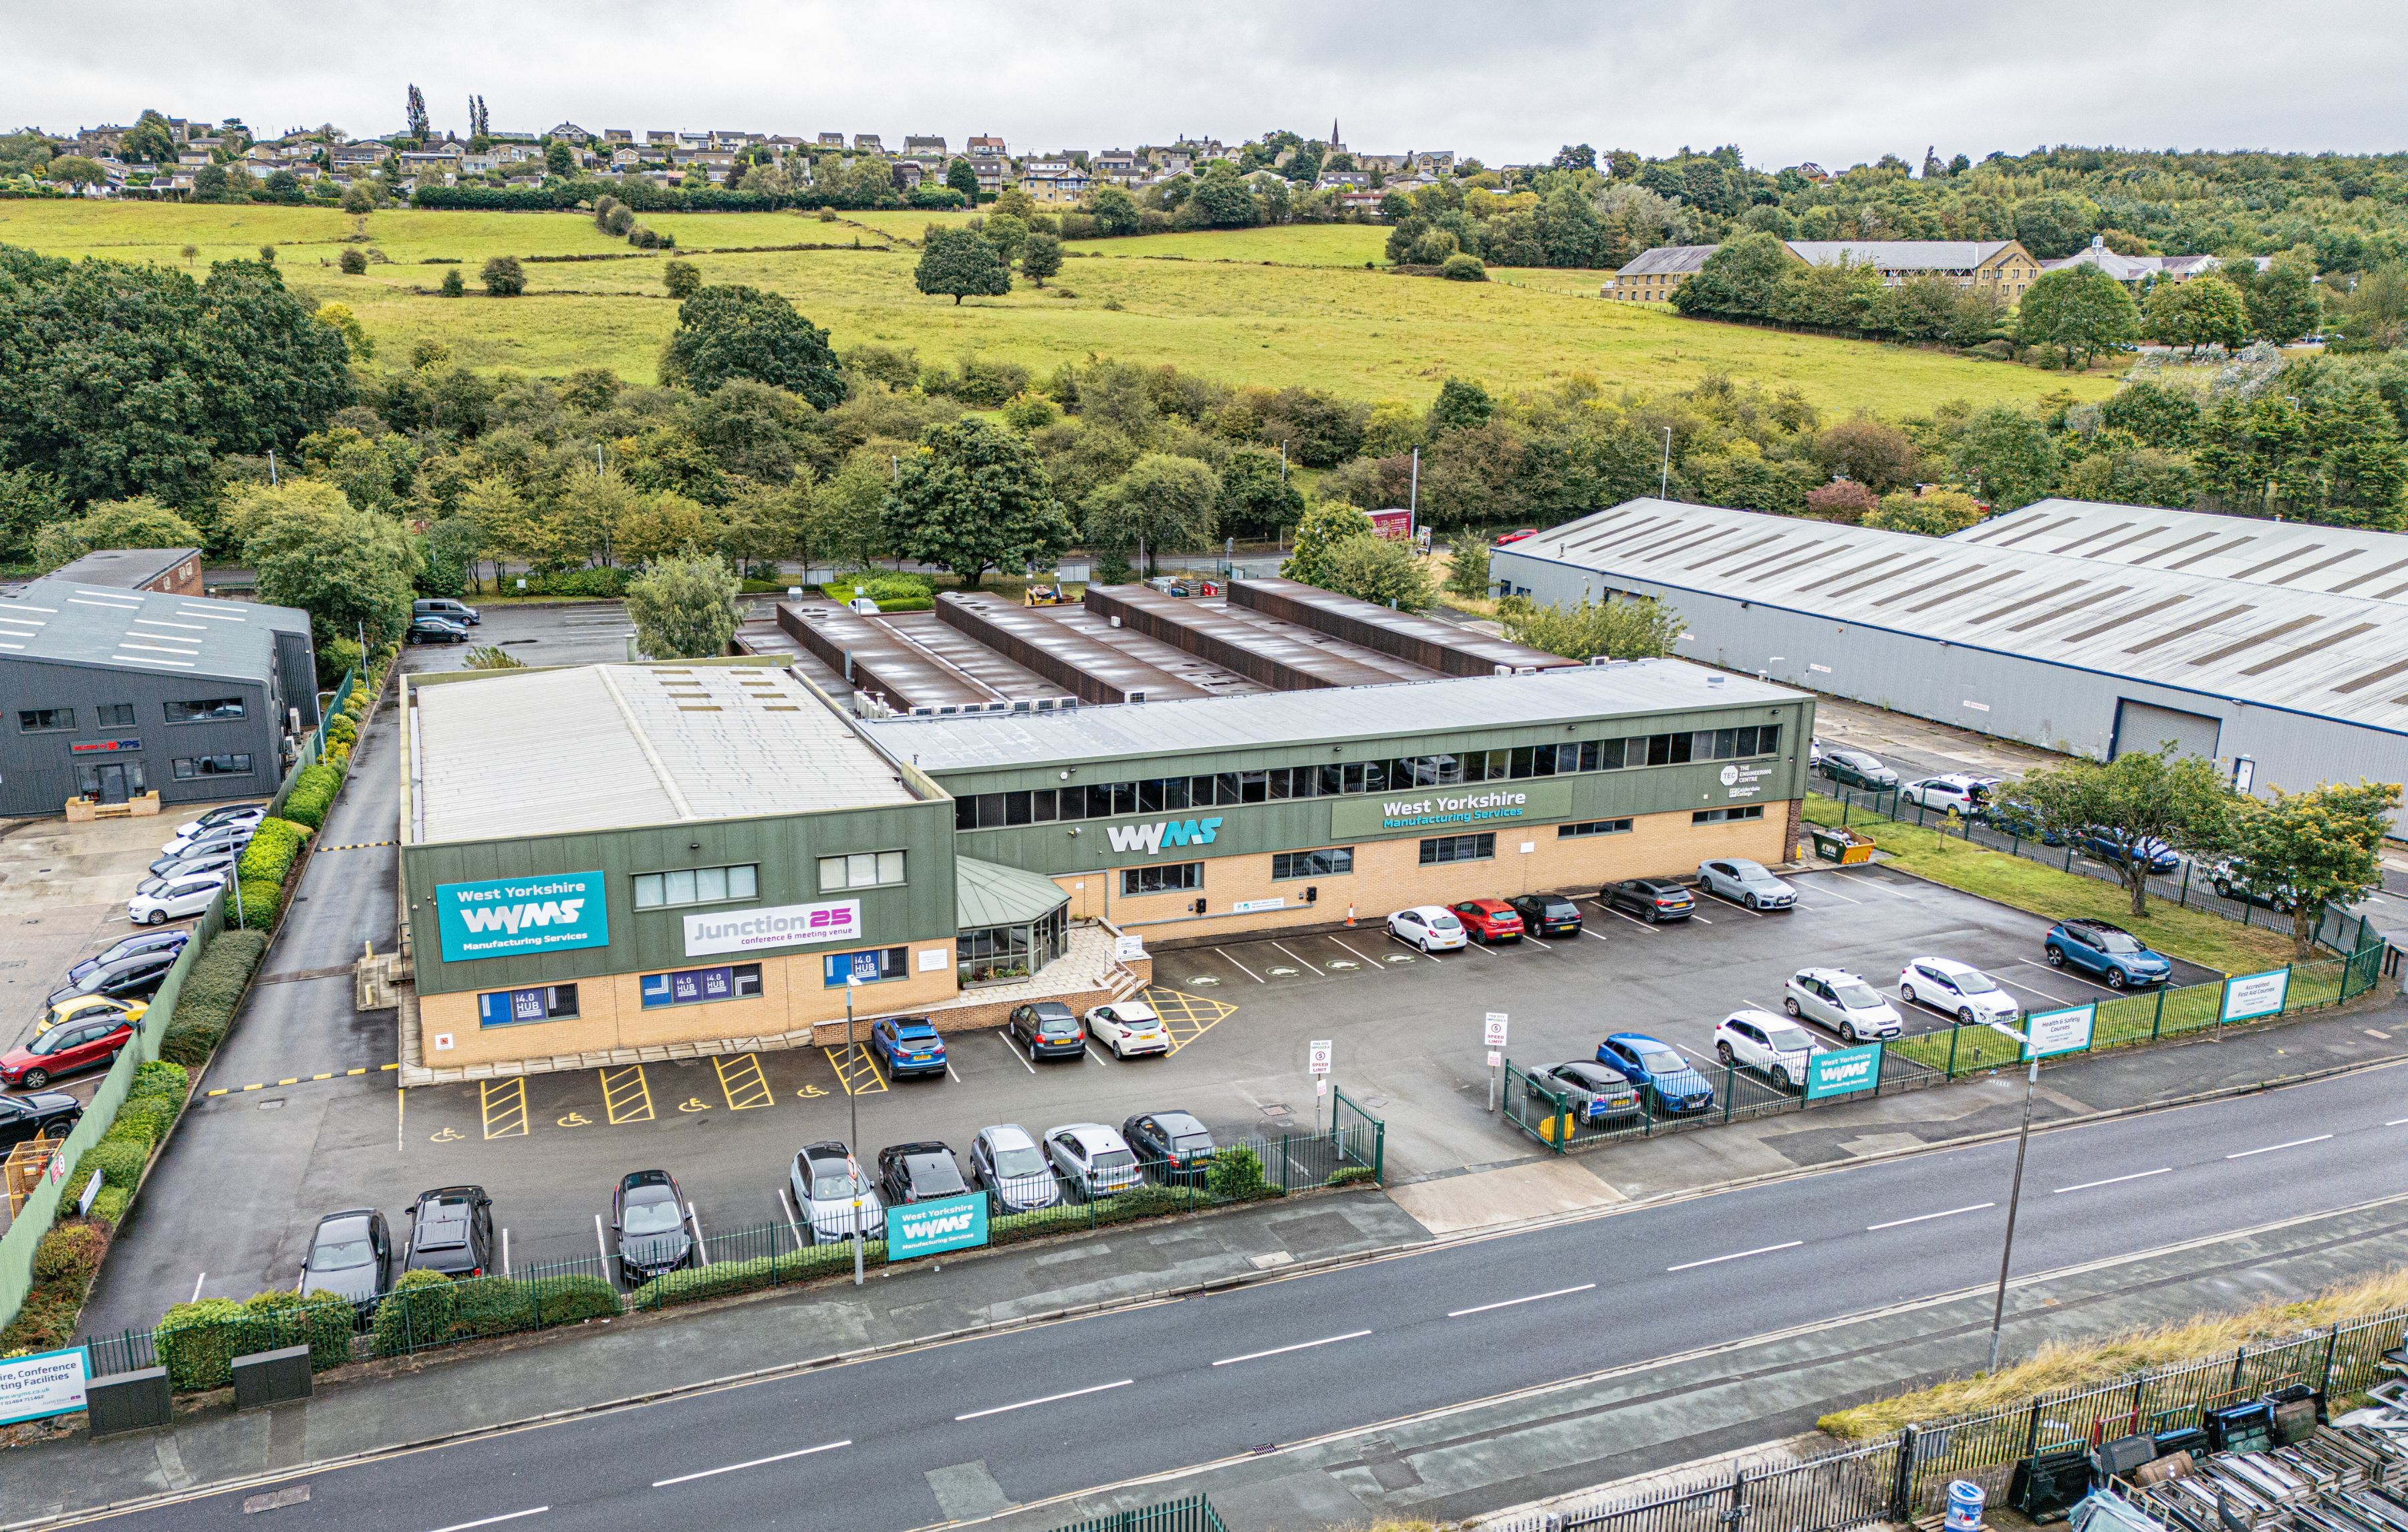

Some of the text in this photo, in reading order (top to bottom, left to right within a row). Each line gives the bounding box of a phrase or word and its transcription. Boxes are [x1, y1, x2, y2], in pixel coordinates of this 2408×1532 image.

[118, 740, 139, 749] YPS
[1740, 769, 1772, 777] ENGINEERING
[1383, 791, 1526, 816] West Yorkshire
[1383, 807, 1523, 828] Manufacturing Services
[1106, 817, 1223, 855] WYMS
[457, 882, 585, 902] West Yorkshire
[459, 898, 585, 934] WYMS
[694, 908, 852, 940] Junction 25
[463, 932, 587, 950] Manufacturing Services
[741, 934, 785, 944] conference
[795, 930, 827, 938] meeting
[829, 927, 852, 935] venue
[855, 955, 871, 965] i4.0
[855, 963, 875, 972] HUB
[677, 977, 692, 985] i4.0
[707, 973, 721, 982] i4.0
[707, 980, 725, 989] HUB
[677, 984, 695, 992] HUB
[2246, 982, 2270, 990] Accredited
[516, 993, 535, 1003] i4.0
[517, 1002, 539, 1011] HUB
[1840, 1053, 1871, 1063] Yorkshire
[1820, 1061, 1871, 1081] WYMS
[1818, 1081, 1850, 1090] Manufacturing
[902, 1204, 974, 1221] West Yorkshire
[902, 1212, 973, 1239] WYMS
[902, 1233, 974, 1250] Manufacturing Services
[18, 1362, 76, 1378] Conference
[1, 1373, 69, 1390] ting Facilities
